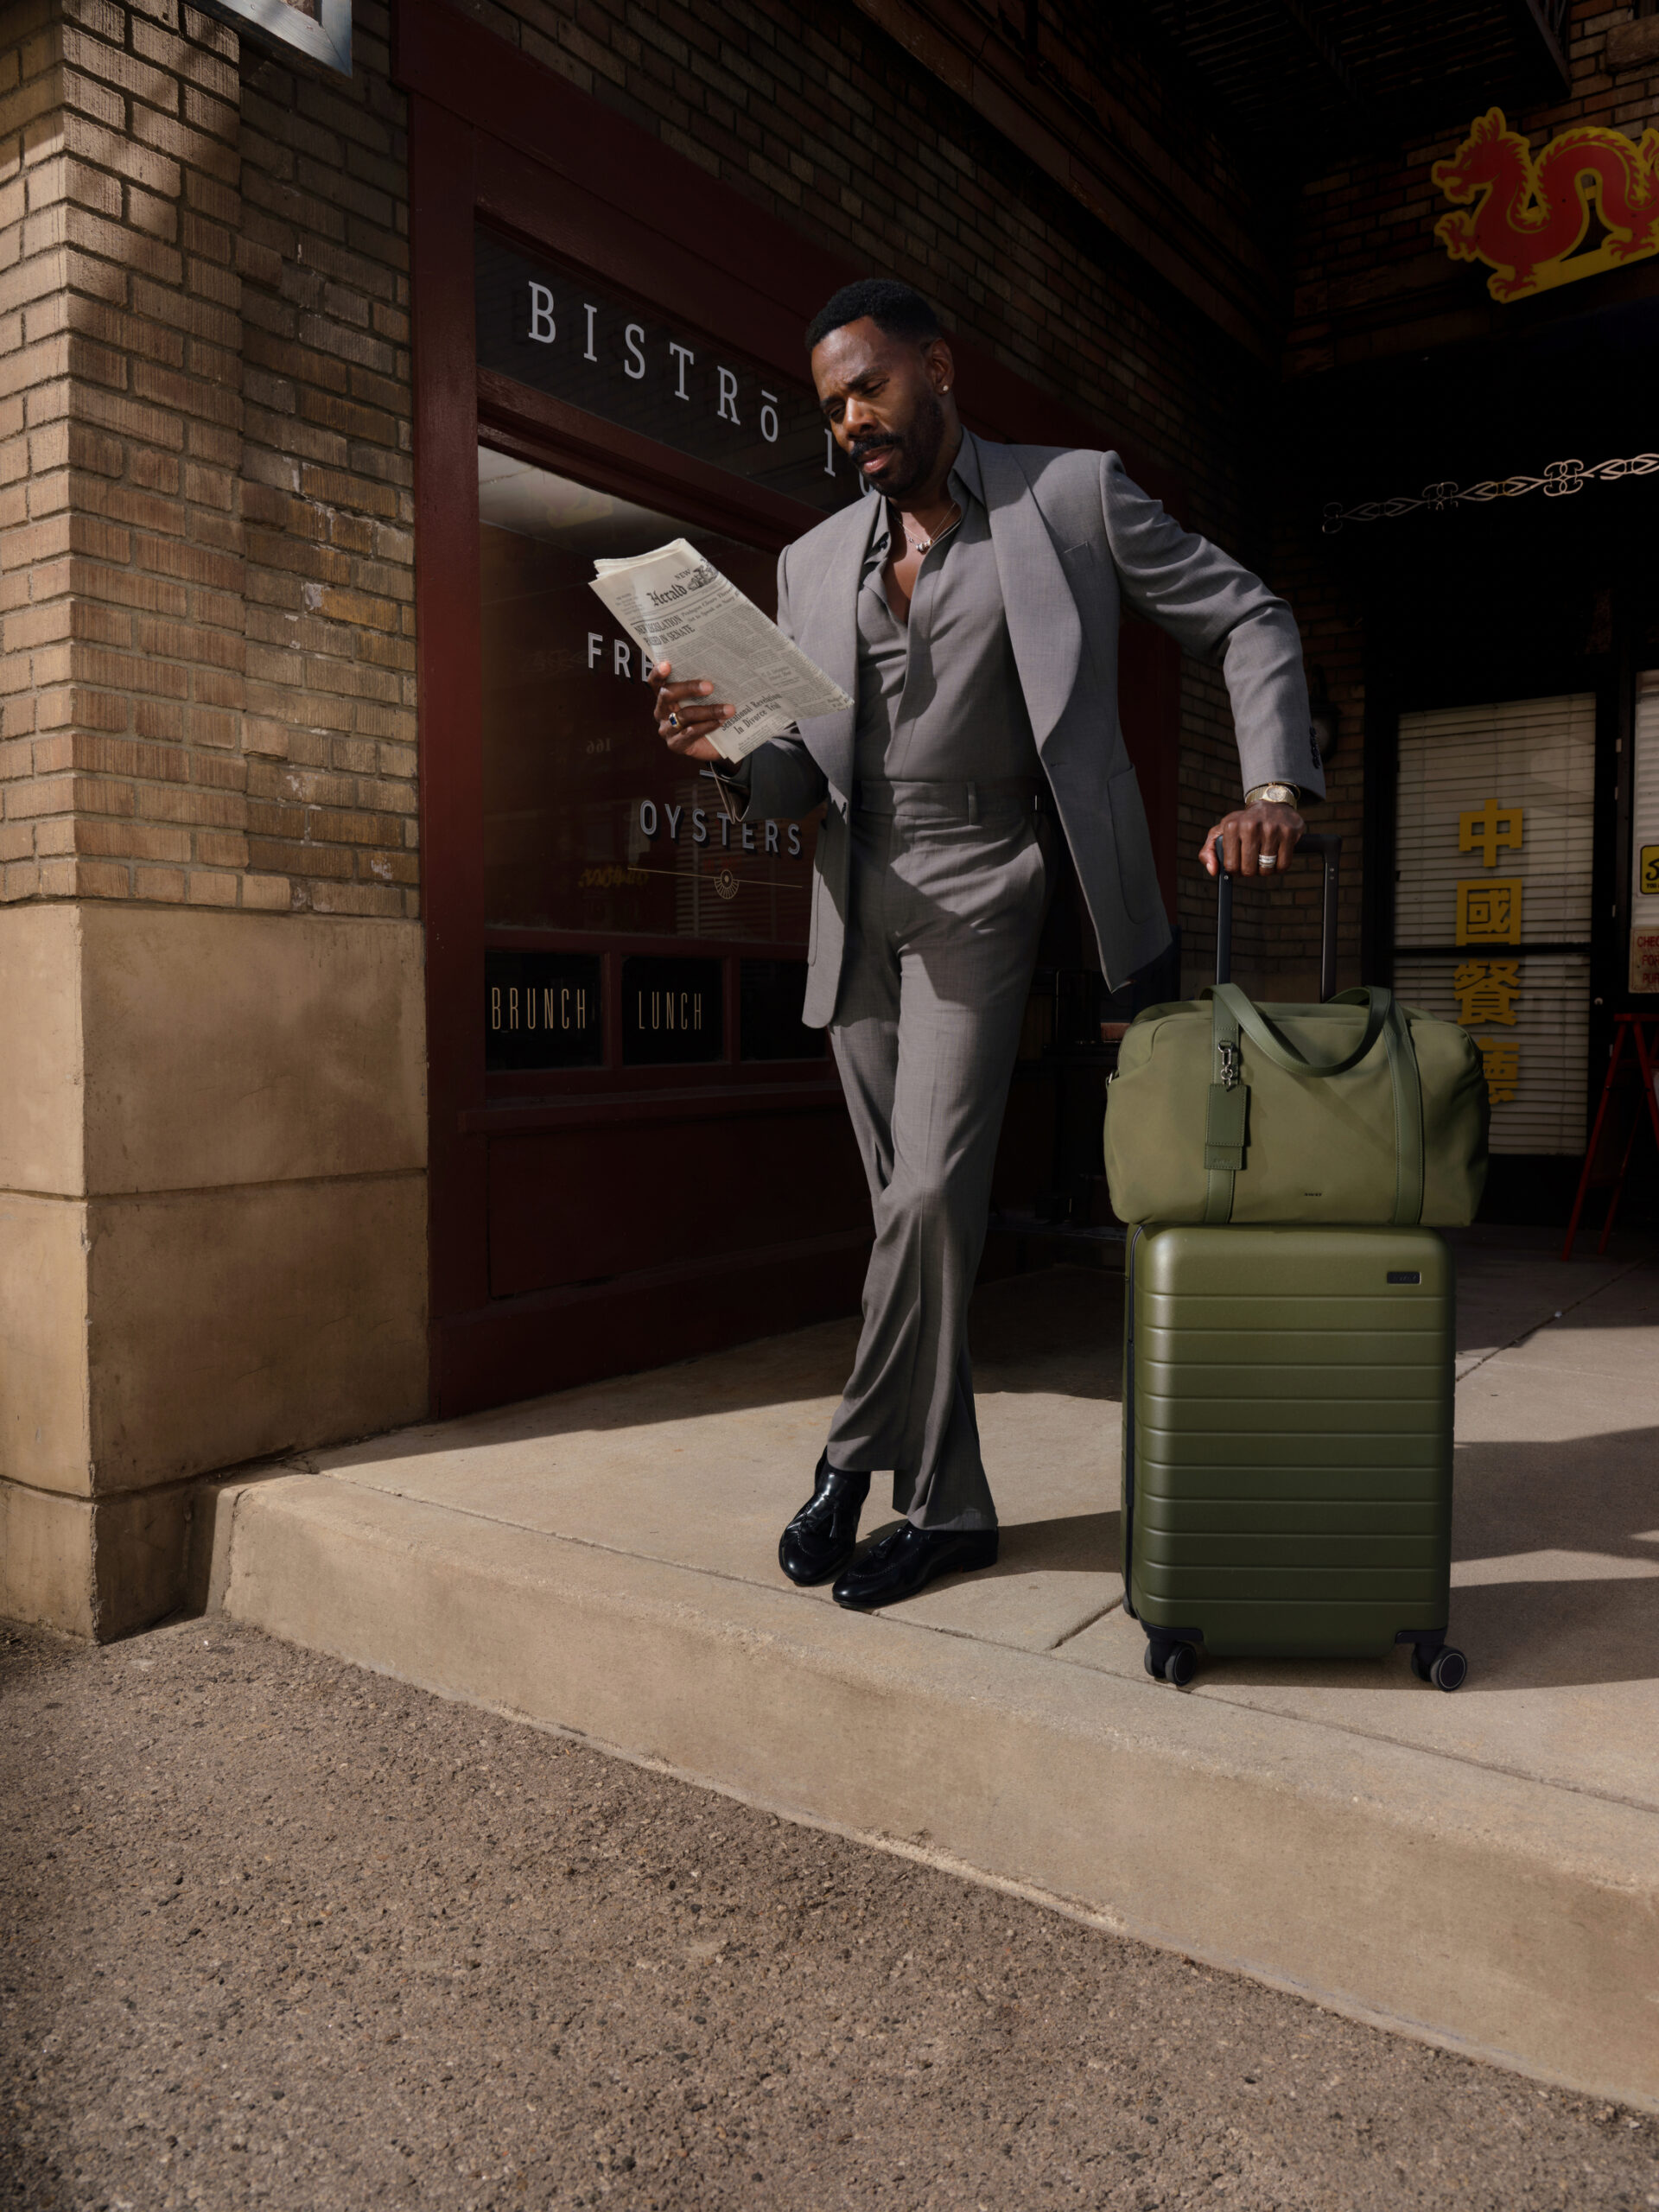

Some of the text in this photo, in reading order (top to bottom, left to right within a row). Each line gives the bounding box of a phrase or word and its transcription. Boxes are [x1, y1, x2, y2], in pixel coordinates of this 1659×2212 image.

[674, 568, 691, 581] NEW
[646, 584, 688, 607] Herald
[668, 624, 696, 641] SENATE
[733, 724, 745, 735] In
[745, 710, 767, 728] Divorce
[639, 799, 802, 855] OYSTERS
[492, 987, 586, 1030] BRUNCH
[639, 990, 702, 1030] LUNCH
